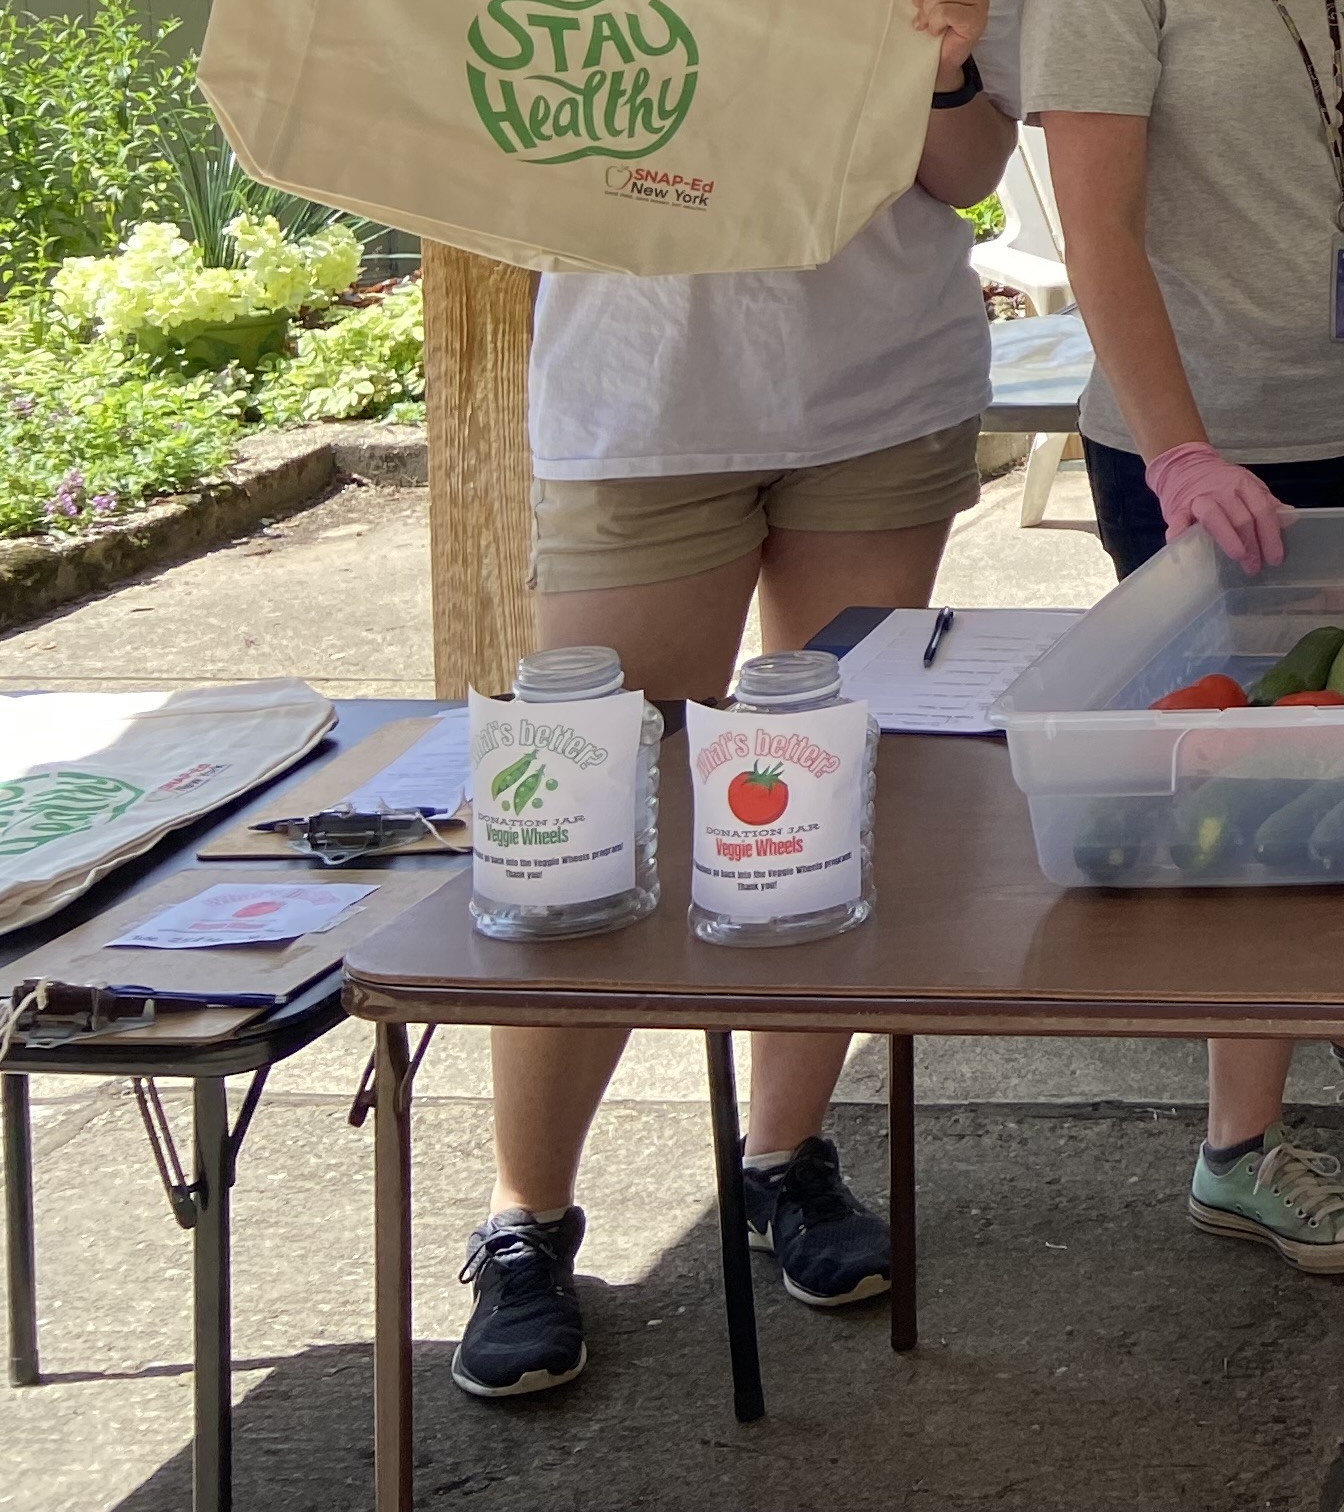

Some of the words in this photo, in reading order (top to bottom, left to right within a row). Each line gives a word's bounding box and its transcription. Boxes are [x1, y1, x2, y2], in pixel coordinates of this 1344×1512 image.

[466, 60, 700, 164] Healthy
[630, 181, 669, 199] New
[675, 188, 710, 207] York
[633, 168, 715, 194] SNAP-Ed
[518, 718, 609, 771] better?
[754, 727, 841, 780] better?
[477, 812, 548, 828] DONATION
[551, 814, 586, 827] JAR
[705, 825, 783, 839] DONATION
[786, 823, 821, 836] JAR
[485, 823, 520, 849] Veggie
[520, 825, 570, 847] Wheels
[715, 837, 753, 863] Veggie
[754, 835, 804, 858] Wheels
[736, 881, 760, 892] Thank
